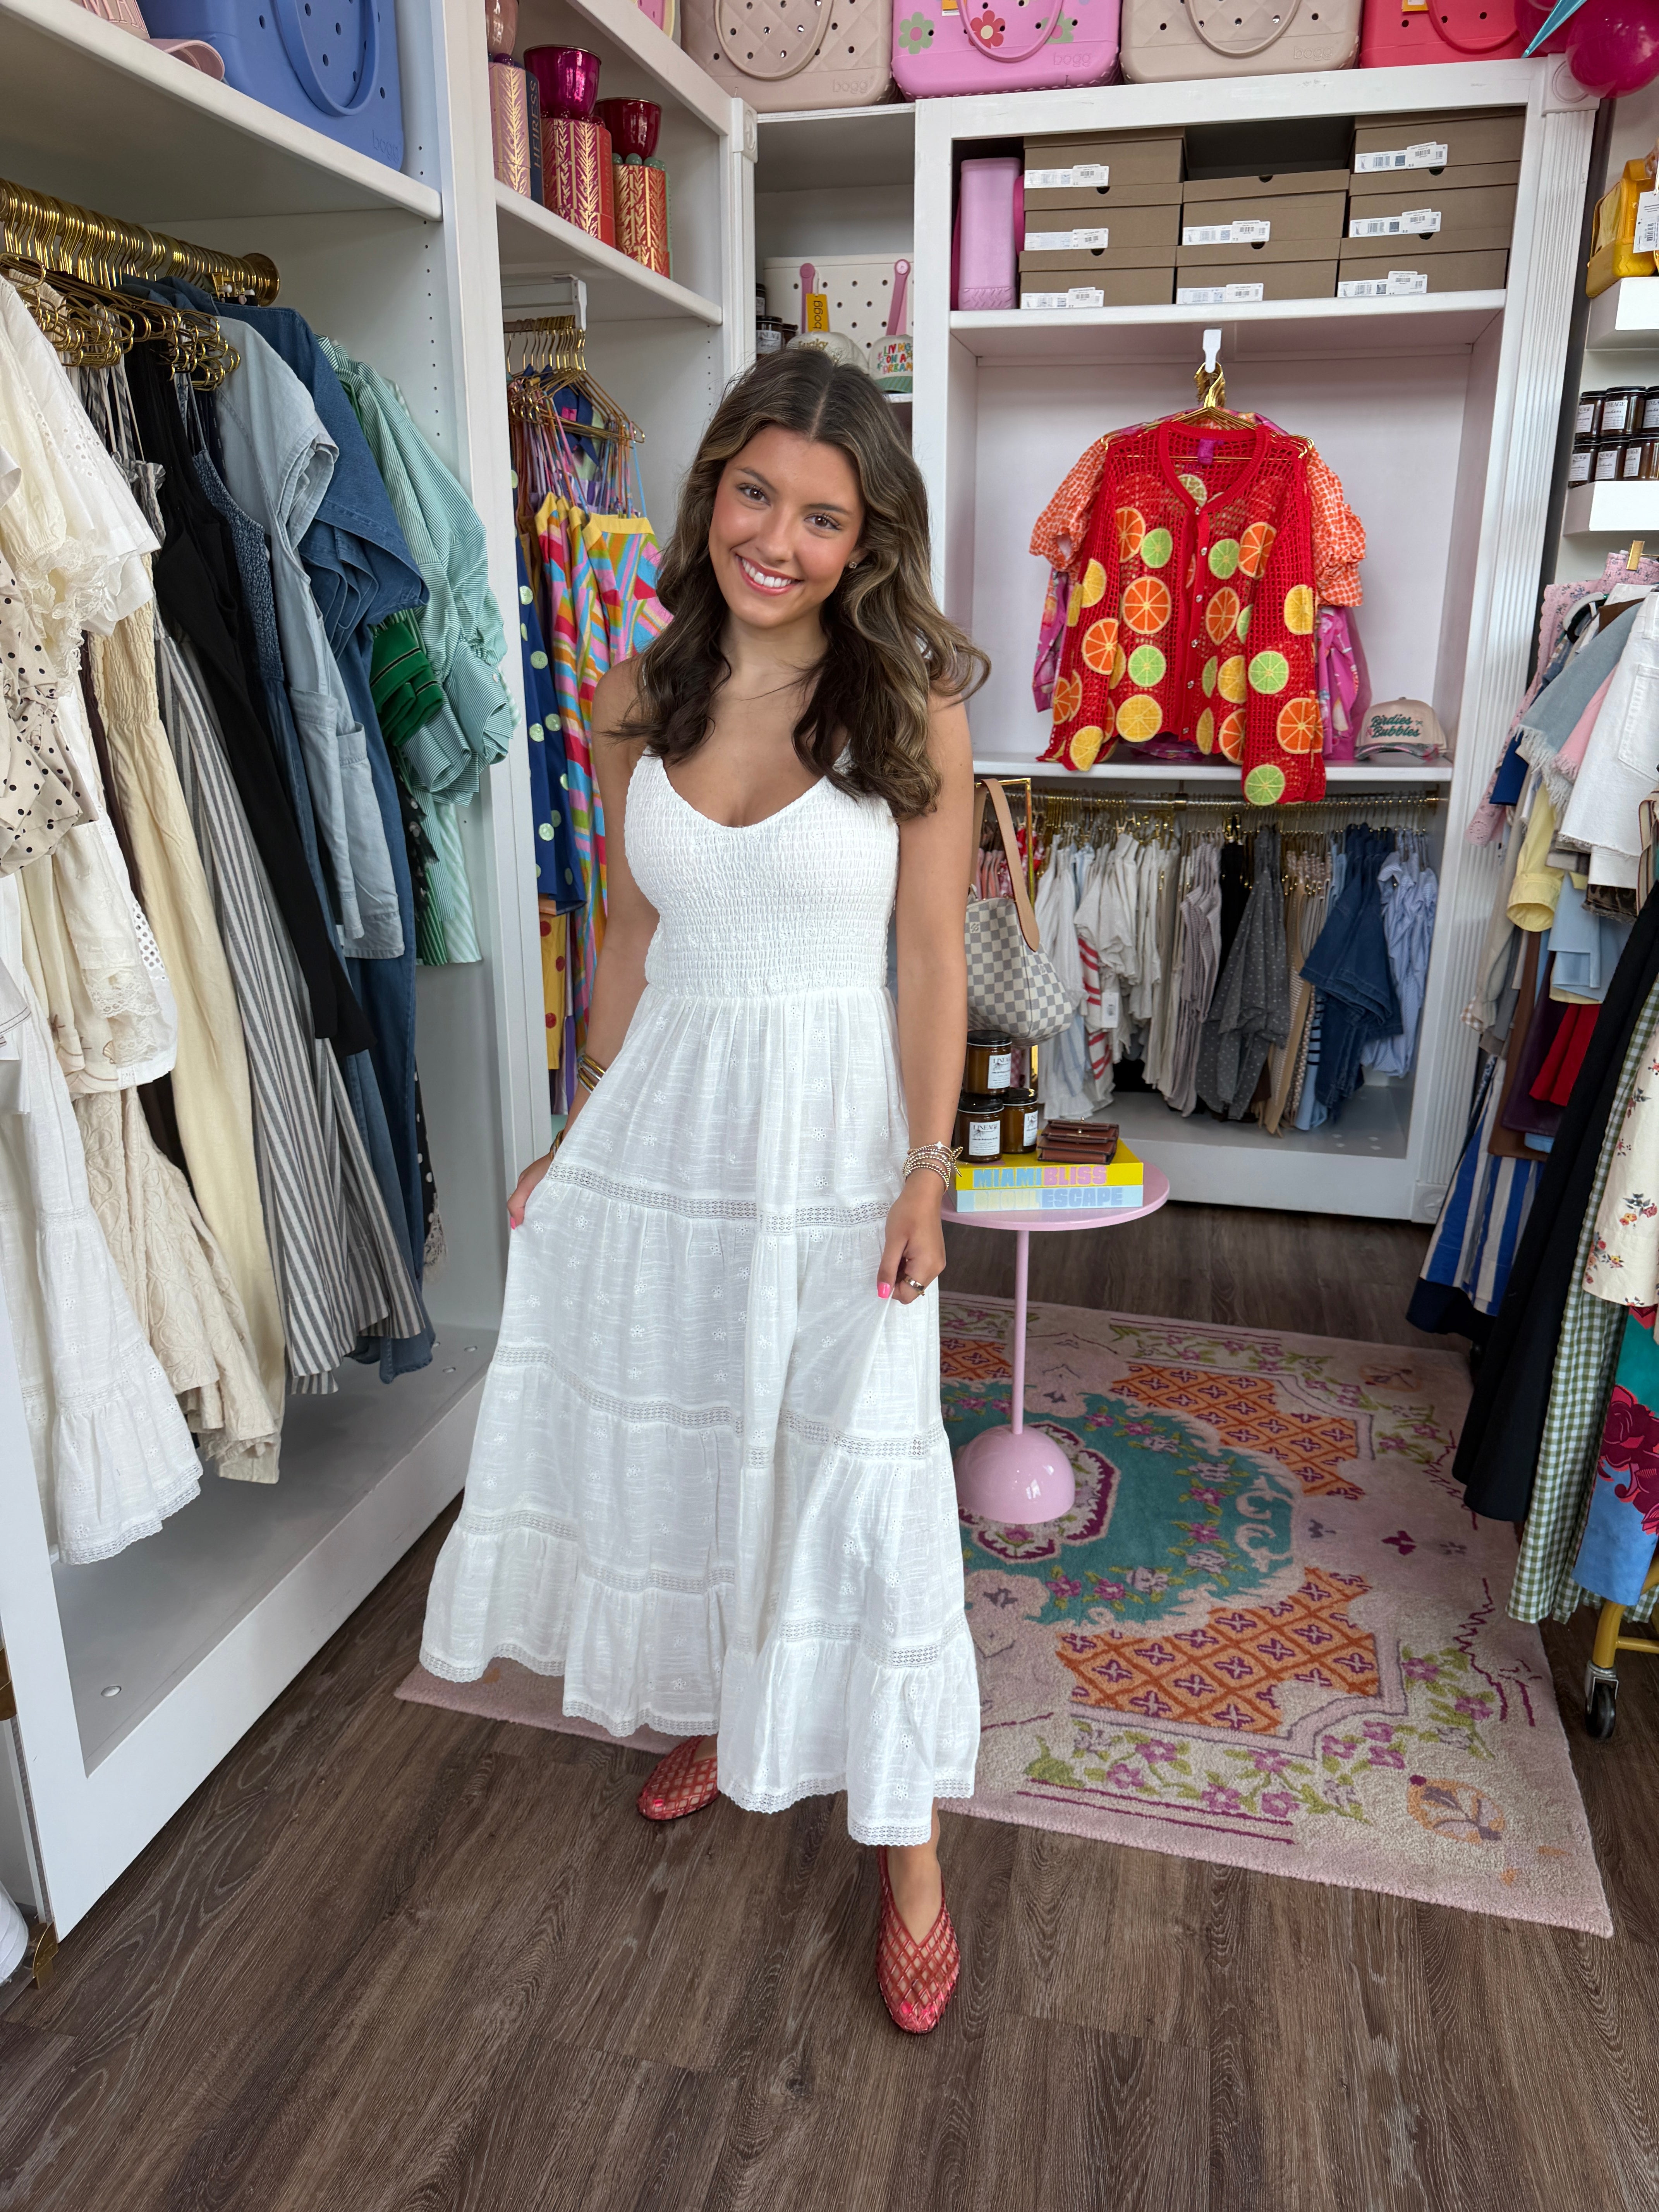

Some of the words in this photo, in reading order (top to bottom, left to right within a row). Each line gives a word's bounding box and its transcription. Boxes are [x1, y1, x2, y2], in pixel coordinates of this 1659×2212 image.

[1054, 52, 1092, 68] bogg
[1294, 46, 1333, 62] bogg
[833, 79, 868, 94] bogg
[530, 80, 541, 168] HEIRESS
[372, 130, 399, 164] bogg
[812, 301, 823, 329] bogg
[1370, 714, 1413, 728] Birdies
[1371, 725, 1421, 738] Bubbles
[973, 1167, 1042, 1188] MIAMI
[1043, 1166, 1108, 1186] BLISS
[1042, 1187, 1123, 1208] ESCAPE
